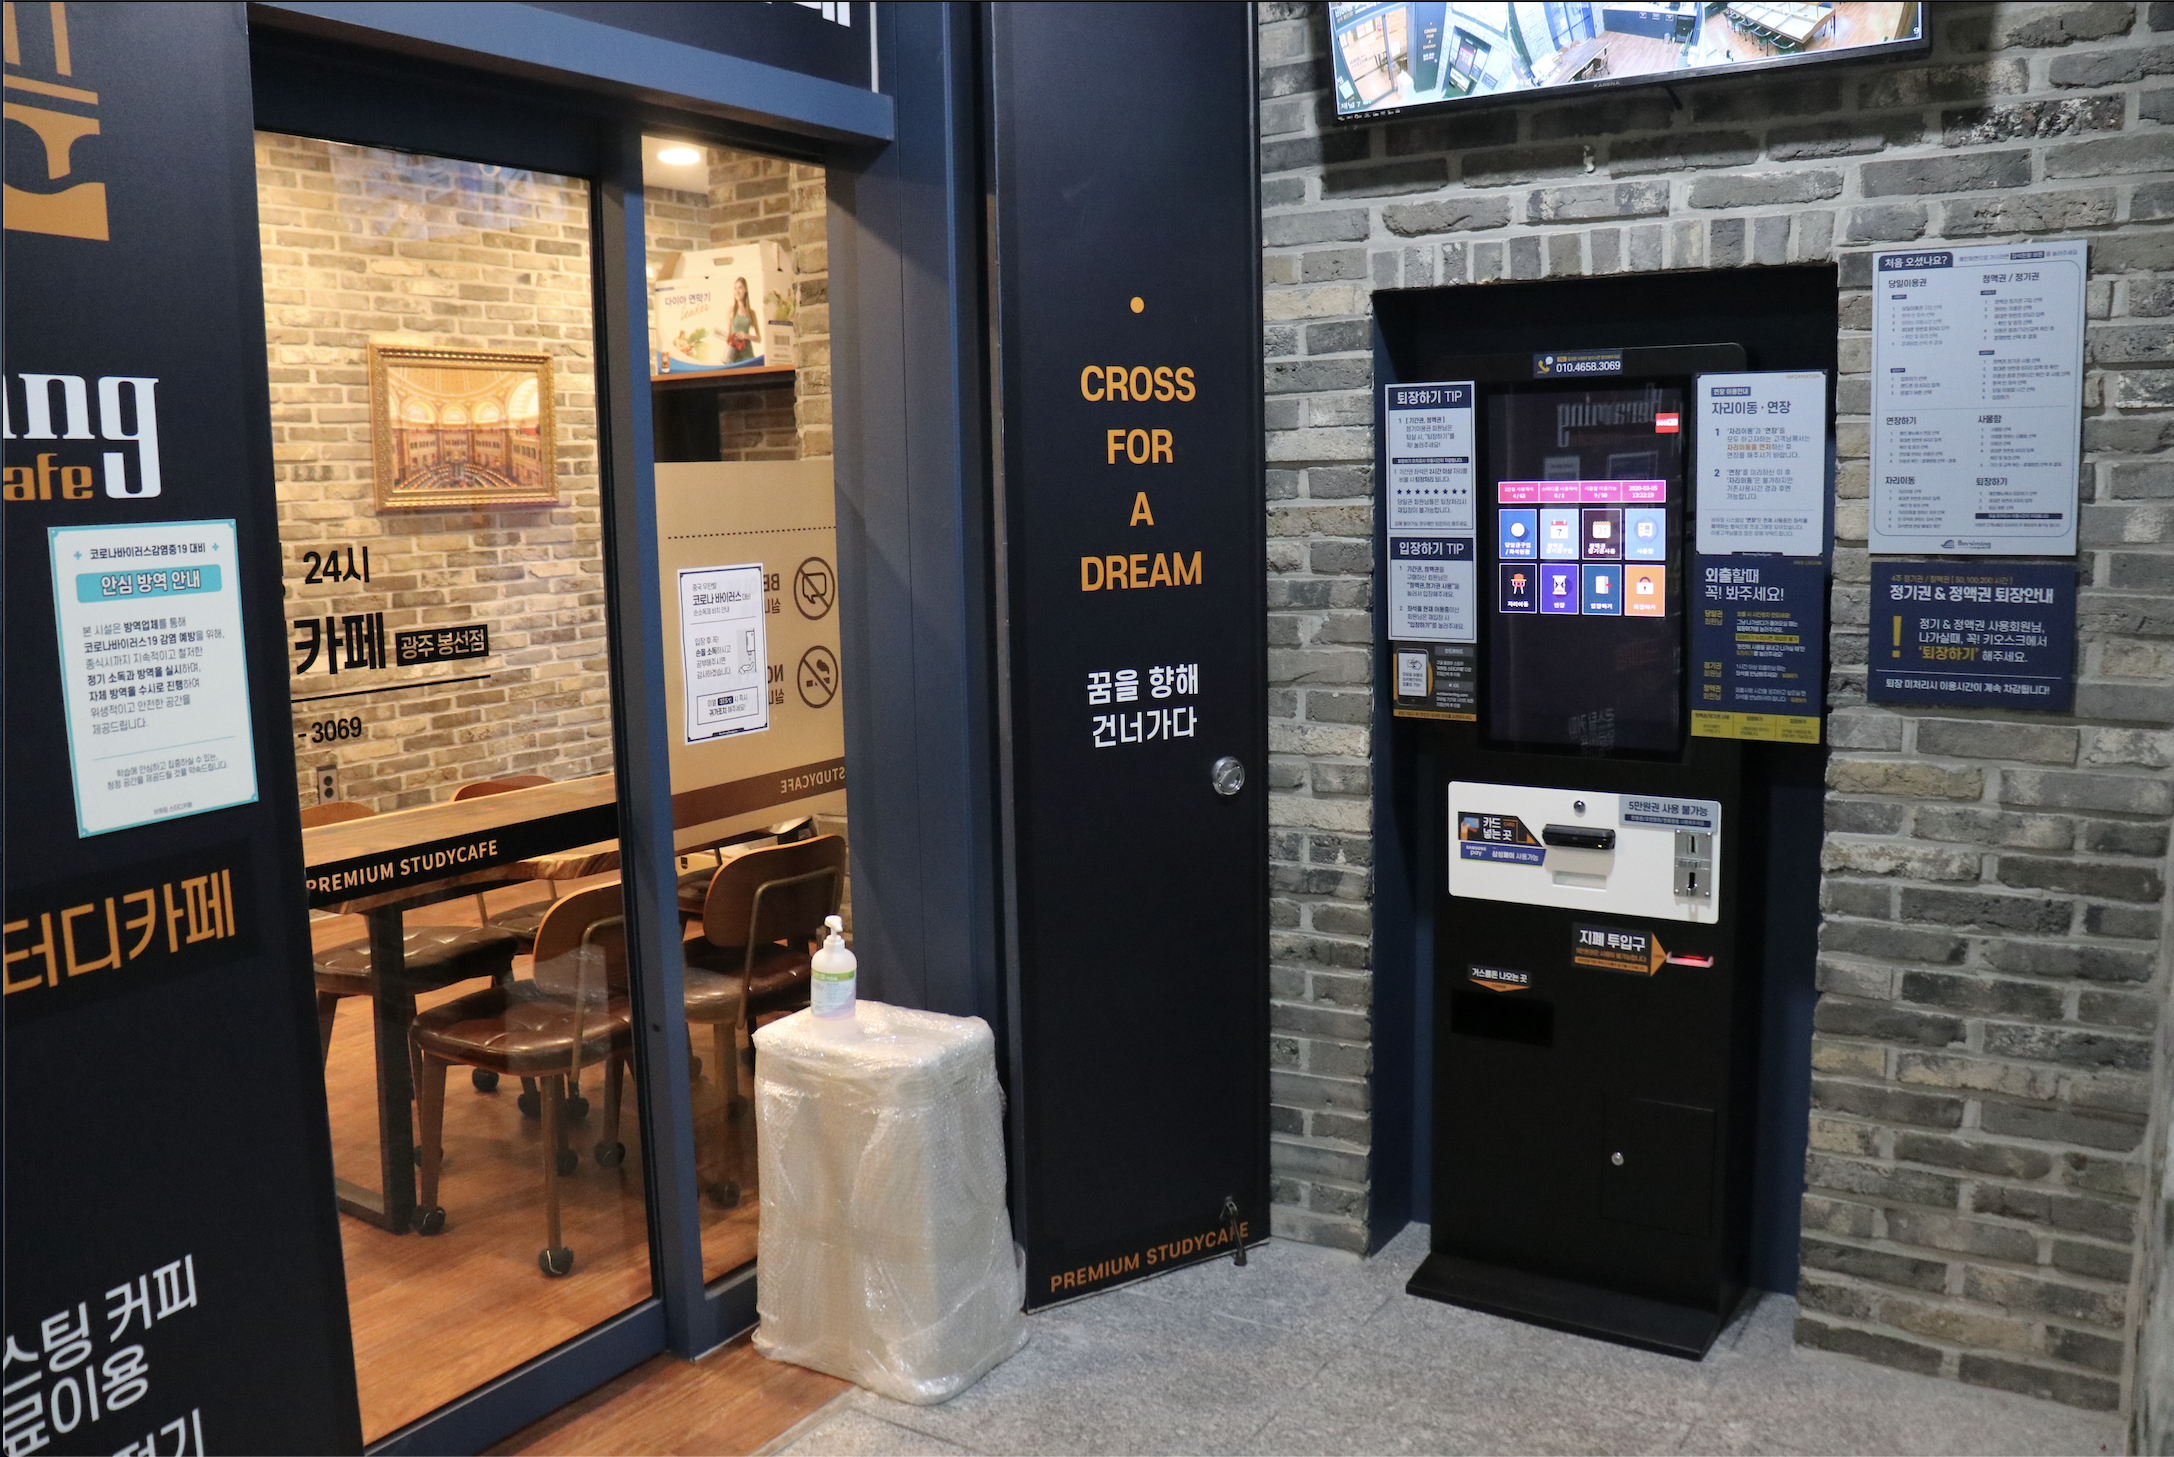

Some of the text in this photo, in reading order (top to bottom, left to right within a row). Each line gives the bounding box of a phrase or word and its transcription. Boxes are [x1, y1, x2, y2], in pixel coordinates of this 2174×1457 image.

[1885, 256, 1947, 268] 처음 오셨나요?
[1888, 278, 1926, 288] 당일이용권
[1982, 272, 2039, 283] 정액권 정기권
[1556, 361, 1621, 372] 010.4658.3069
[1081, 365, 1196, 402] CROSS
[1397, 391, 1462, 404] 퇴장하기 TIP
[1712, 401, 1791, 415] 자리이동 연장
[1886, 416, 1917, 426] 연장하기
[1977, 415, 2001, 424] 사물함
[1715, 428, 1719, 436] 1
[1107, 428, 1173, 465] FOR
[1714, 469, 1720, 477] 2
[1885, 477, 1915, 485] 자리이동
[1976, 477, 2008, 486] 퇴장하기
[1130, 492, 1154, 526] A
[89, 543, 206, 560] 코로나바이러스감염증19 대비
[1399, 542, 1464, 555] 입장하기 TIP
[303, 546, 369, 585] 24시
[1081, 551, 1202, 591] DREAM
[101, 569, 201, 597] 안심 방역 안내
[1705, 568, 1759, 584] 외출할때
[693, 591, 741, 606] 코로나 바이러스
[1705, 585, 1784, 602] 꼭! 봐주세요!
[1889, 585, 2054, 604] 정기권 & 정액권 퇴장안내
[83, 617, 186, 637] 본 시설은 방역업체를 통해
[1919, 618, 2045, 633] 정기 & 정액권 사용회원님,
[84, 629, 224, 653] 코로나바이러스19 감염 예방을 위해,
[294, 612, 386, 675] 카페
[400, 629, 485, 660] 광주 봉선점
[1919, 632, 2047, 647] 나가실때, 꼭! 키오스크에서
[86, 647, 203, 670] 종식시까지 지속적이고 철저한
[696, 649, 705, 657] 손을
[1982, 650, 2028, 663] 해주세요.
[88, 663, 201, 686] 정기 소독과 방역을 실시하며,
[89, 678, 199, 702] 자체 방역을 수시로 진행하여
[1087, 663, 1198, 705] 꿈을 향해
[1886, 679, 2050, 695] 퇴장 미처리시 이용시간이 계속 차감됩니다!
[91, 694, 191, 718] 위생적이고 안전한 공간을
[92, 718, 148, 735] 제공드립니다.
[311, 717, 362, 744] 3069
[1092, 706, 1198, 748] 건너가다
[195, 756, 202, 764] 수
[123, 776, 143, 788] 공간을
[1629, 802, 1708, 817] 5만원권 사용 불가능
[1483, 817, 1501, 828] 카드
[1483, 829, 1512, 841] 넣는 곳
[1492, 851, 1538, 861] 삼성페이 사용가능
[306, 839, 498, 892] PREMIUM STUDYCAFE
[3, 869, 235, 995] 터디카페
[1579, 929, 1646, 952] 지폐 투입구
[1472, 968, 1527, 984] 거스름돈 나오는 곳
[1050, 1253, 1139, 1292] PREMIUM
[106, 1254, 198, 1343] 커피
